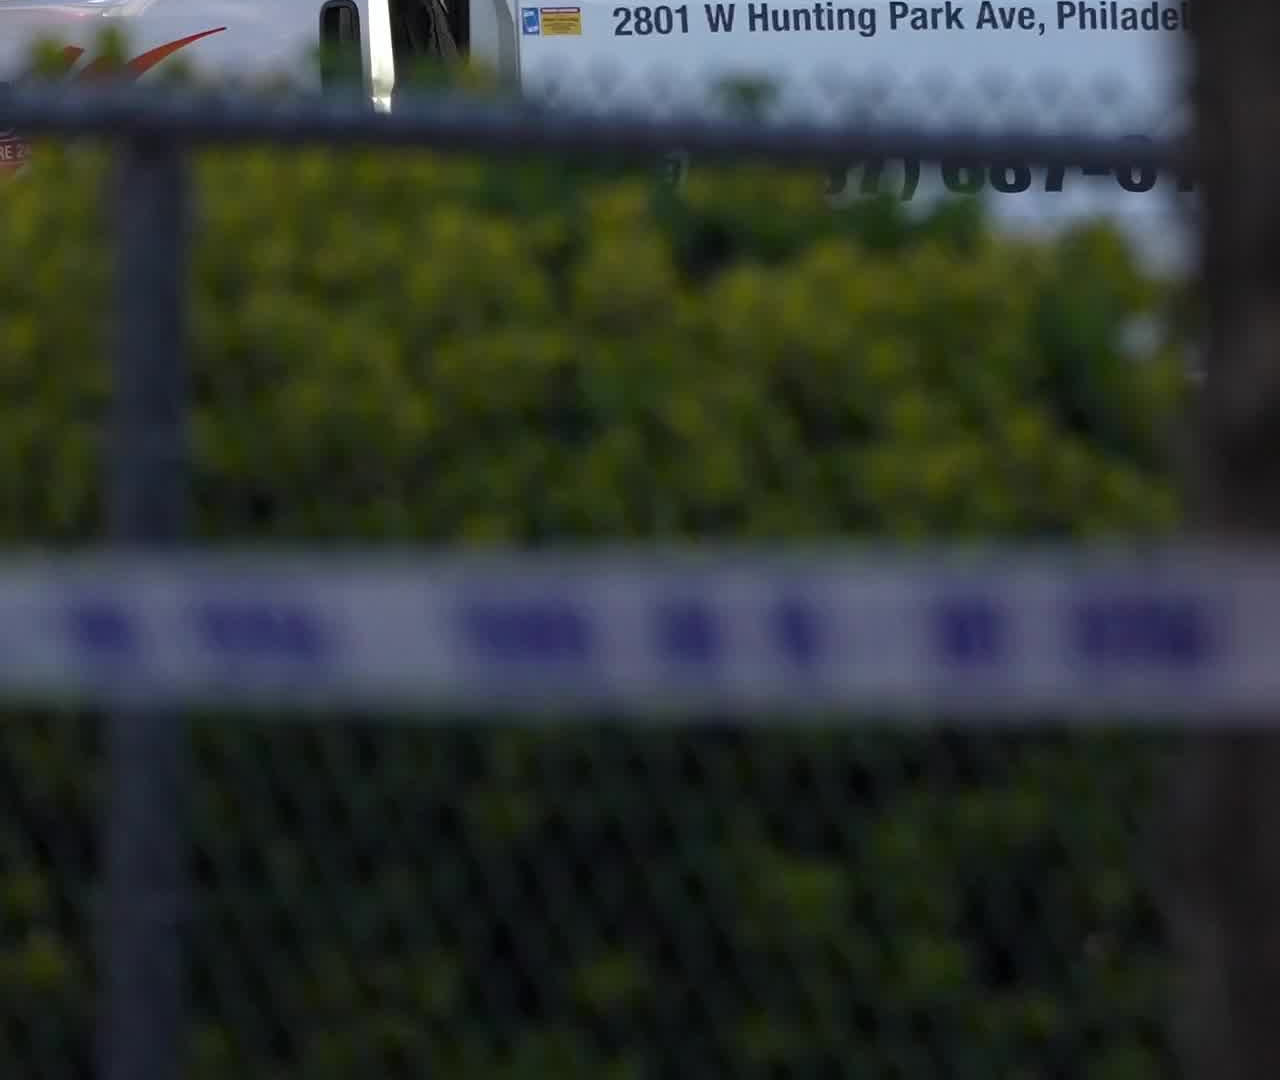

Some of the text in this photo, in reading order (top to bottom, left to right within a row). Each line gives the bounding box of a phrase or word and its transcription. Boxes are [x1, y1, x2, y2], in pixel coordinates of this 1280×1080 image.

[613, 4, 690, 36] 2801
[704, 3, 735, 33] W
[748, 1, 876, 38] Hunting
[889, 0, 964, 31] Park
[976, 0, 1045, 36] Ave,
